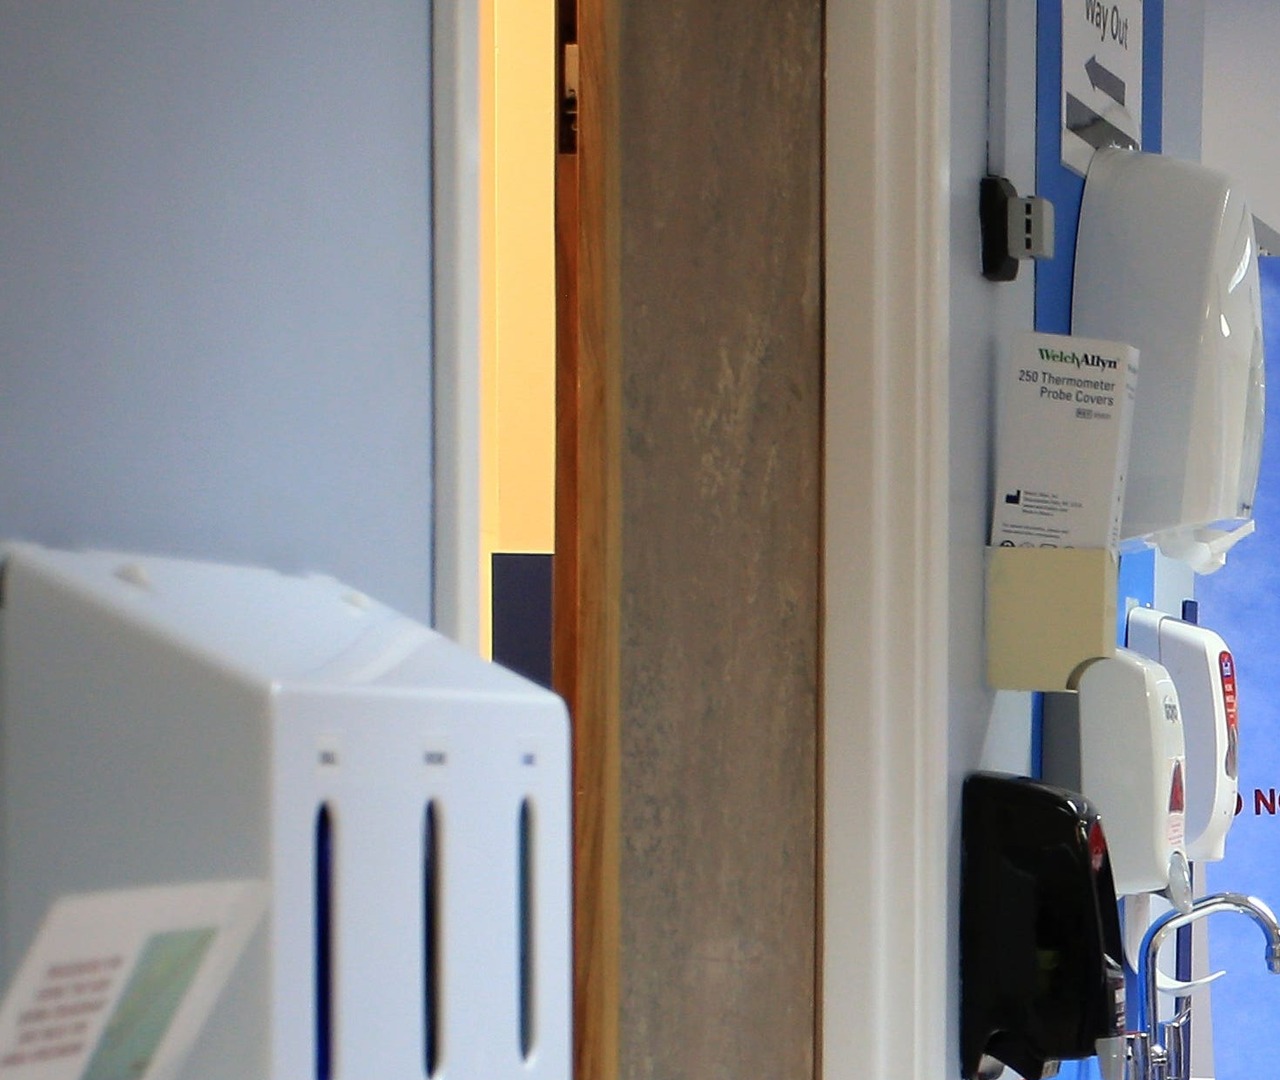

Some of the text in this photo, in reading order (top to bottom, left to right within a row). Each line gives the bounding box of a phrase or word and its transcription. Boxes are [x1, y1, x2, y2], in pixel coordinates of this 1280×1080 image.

[1085, 0, 1128, 50] Way Out
[1019, 369, 1038, 382] 250
[1041, 371, 1116, 391] Thermometer
[1040, 386, 1114, 406] Probe Covers
